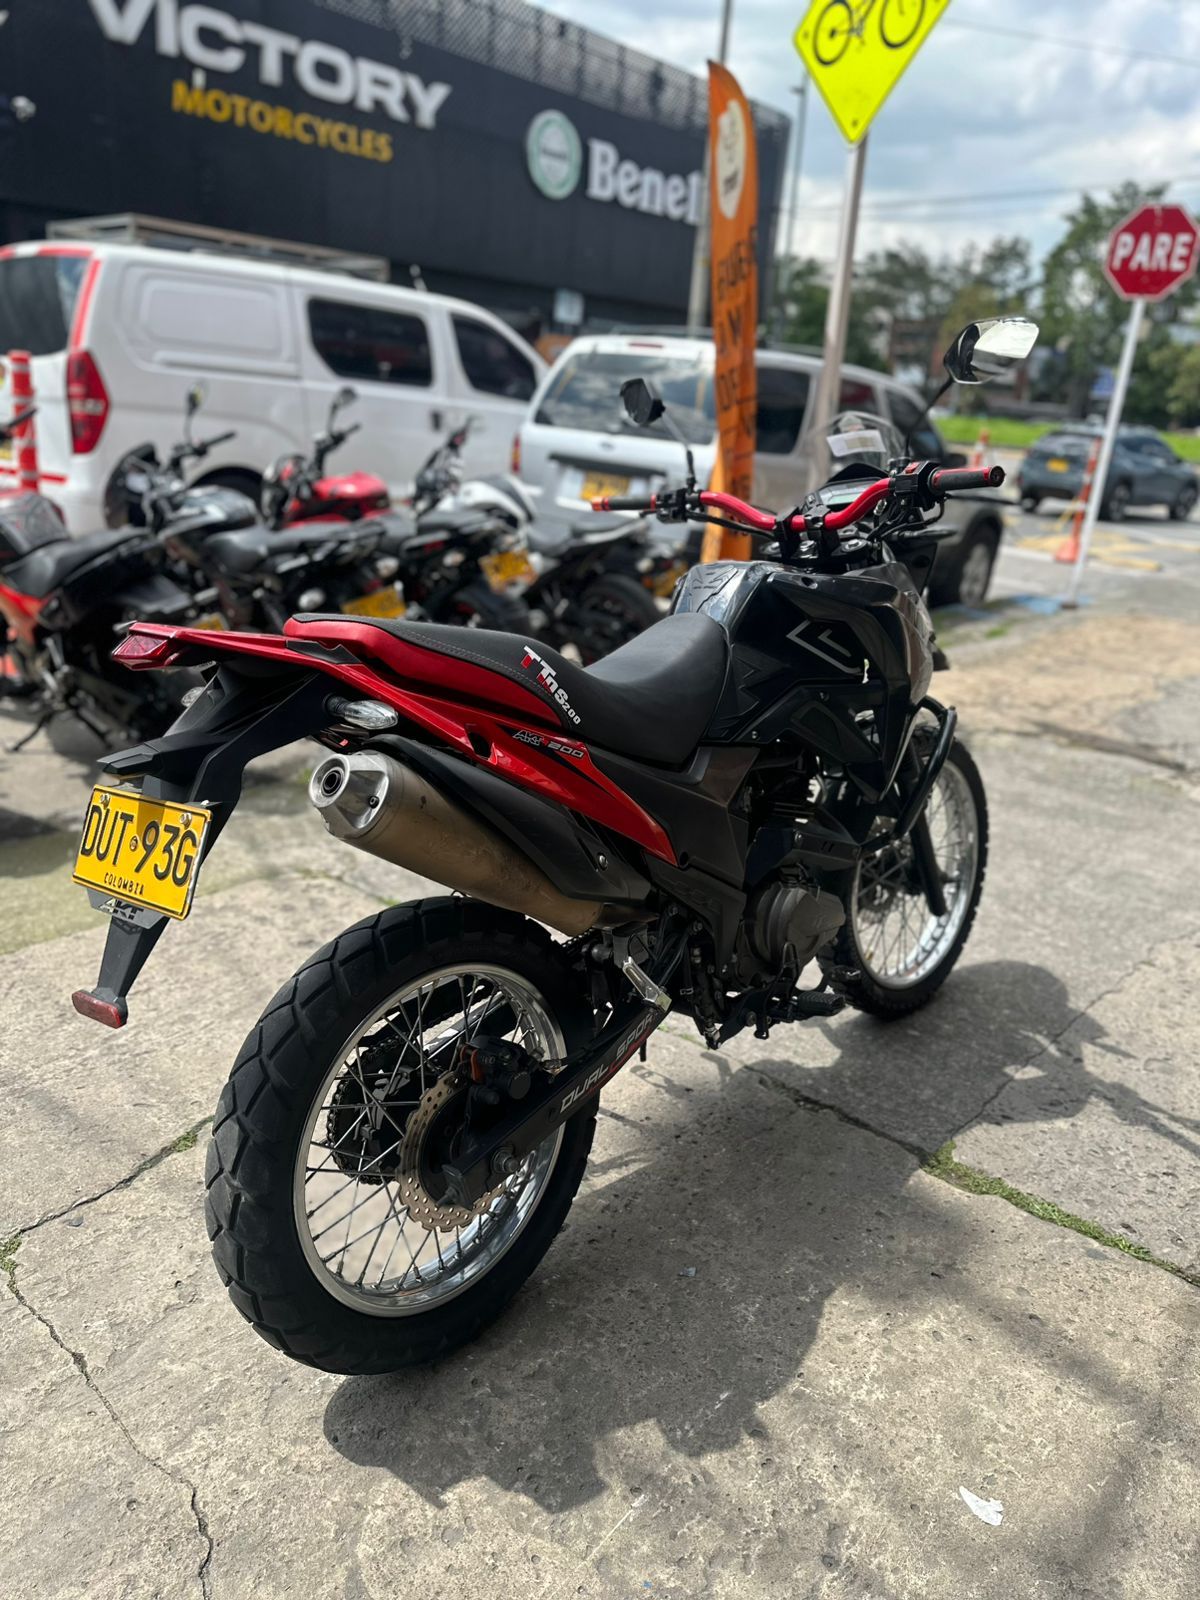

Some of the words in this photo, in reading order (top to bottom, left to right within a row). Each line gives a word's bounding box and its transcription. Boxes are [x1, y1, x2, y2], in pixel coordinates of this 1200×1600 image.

[88, 0, 452, 129] VICTORY
[171, 80, 394, 163] MOTORCYCLES
[587, 137, 703, 225] Benel
[1111, 232, 1193, 272] PARE
[547, 740, 585, 758] 200
[80, 804, 135, 866] DUT
[134, 820, 197, 887] 93G
[103, 872, 145, 896] COLOMBIA
[99, 898, 145, 920] AKT
[560, 1063, 609, 1114] DUAL
[616, 1012, 654, 1060] SPOR
